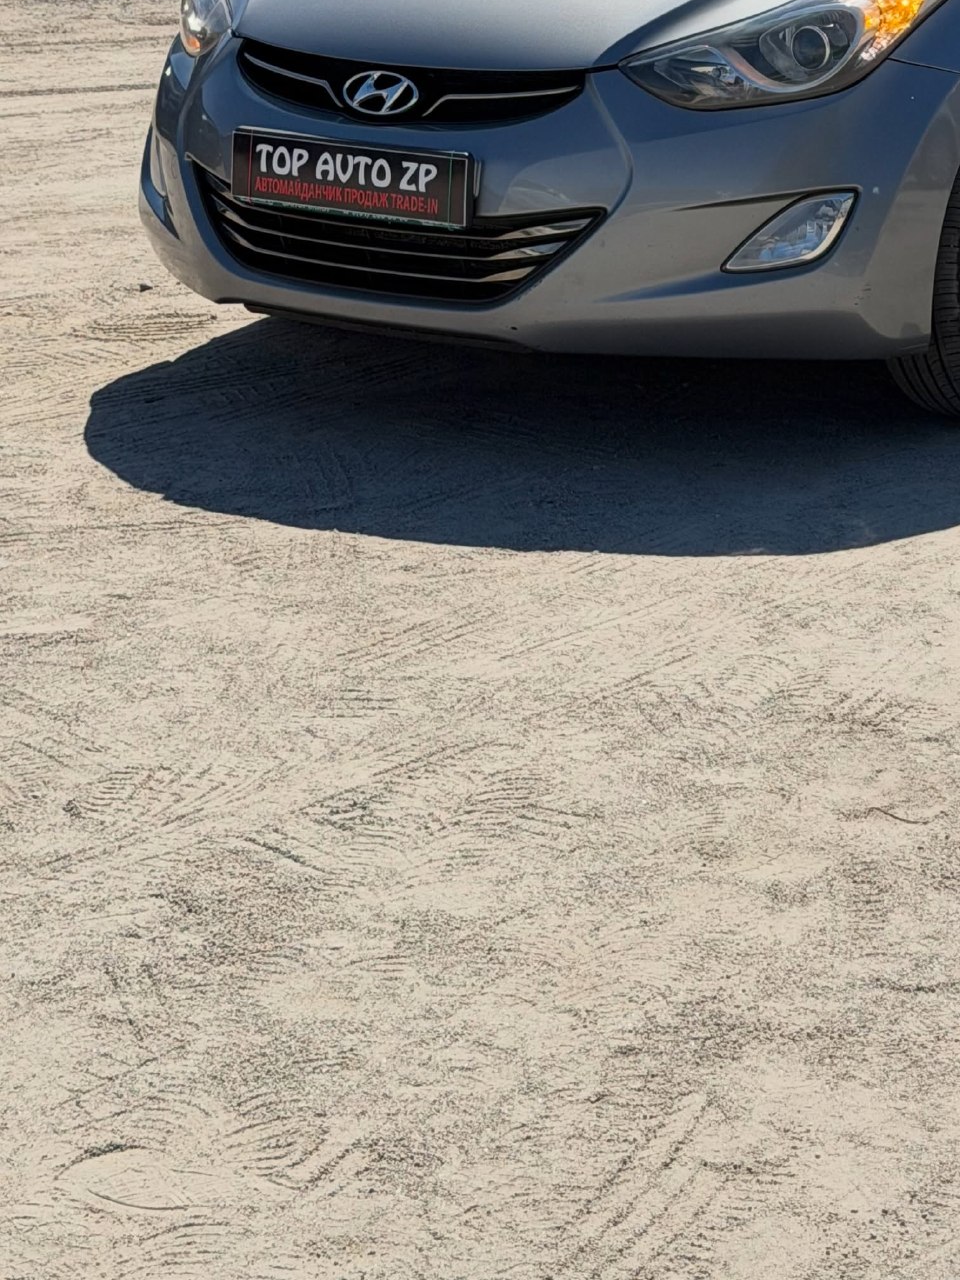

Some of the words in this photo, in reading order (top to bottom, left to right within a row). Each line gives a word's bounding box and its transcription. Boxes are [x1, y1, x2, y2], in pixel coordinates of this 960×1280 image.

[256, 144, 309, 177] TOP
[315, 152, 392, 189] AVTO
[399, 161, 438, 194] ZP
[254, 176, 343, 203] АВТОМАЙДАНЧИК
[344, 188, 389, 209] ПРОДАЖ
[390, 193, 438, 216] TRADE-IN
